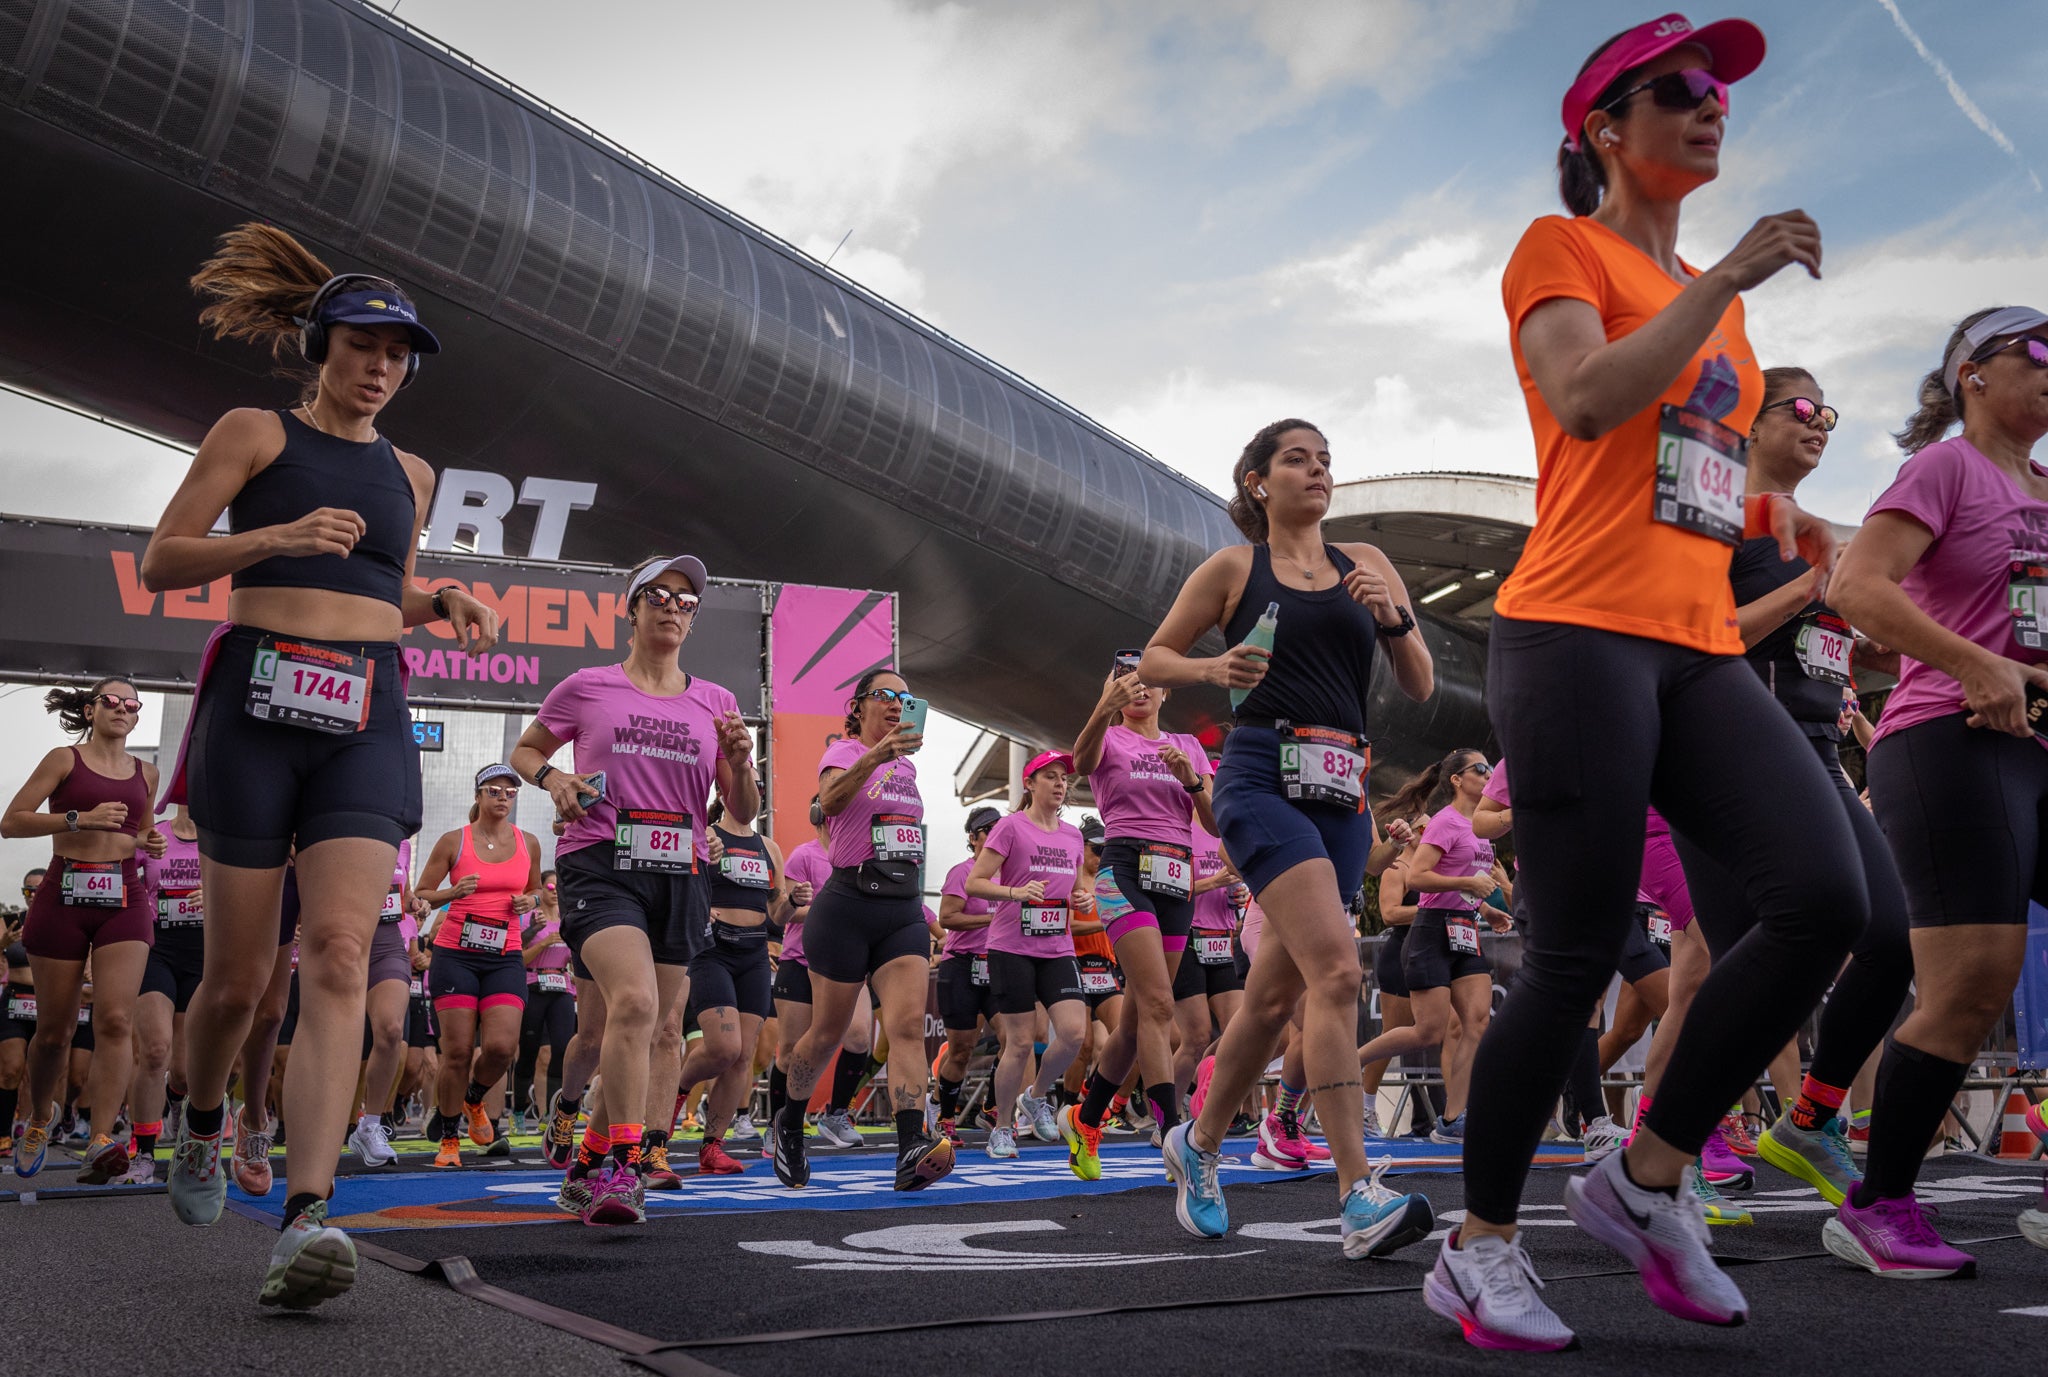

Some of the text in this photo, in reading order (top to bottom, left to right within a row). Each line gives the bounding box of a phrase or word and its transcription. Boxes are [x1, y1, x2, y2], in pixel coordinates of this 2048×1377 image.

[1654, 21, 1694, 38] Je
[1663, 442, 1674, 470] C
[1700, 457, 1733, 502] 634
[275, 641, 354, 667] VENUSWOMEN'S
[1820, 634, 1843, 662] 702
[259, 654, 271, 677] C
[294, 669, 352, 705] 1744
[251, 691, 271, 701] 21.1K
[628, 714, 690, 736] VENUS
[613, 727, 701, 756] WOMEN'S
[612, 743, 698, 766] HALF MARATHON
[1286, 748, 1294, 766] C
[1323, 750, 1353, 780] 831
[1130, 772, 1150, 780] HALF
[1283, 774, 1300, 782] 21.1K
[881, 793, 900, 801] HALF
[620, 828, 628, 843] C
[650, 830, 680, 851] 821
[897, 828, 921, 844] 885
[1037, 846, 1068, 858] VENUS
[741, 860, 761, 873] 692
[1029, 856, 1074, 869] WOMEN'S
[1168, 862, 1182, 879] 83
[87, 876, 112, 891] 641
[179, 902, 204, 914] 84
[1041, 911, 1060, 923] 874
[480, 928, 499, 941] 531
[1462, 928, 1473, 942] 242
[1207, 941, 1228, 952] 1067
[1091, 975, 1108, 985] 286
